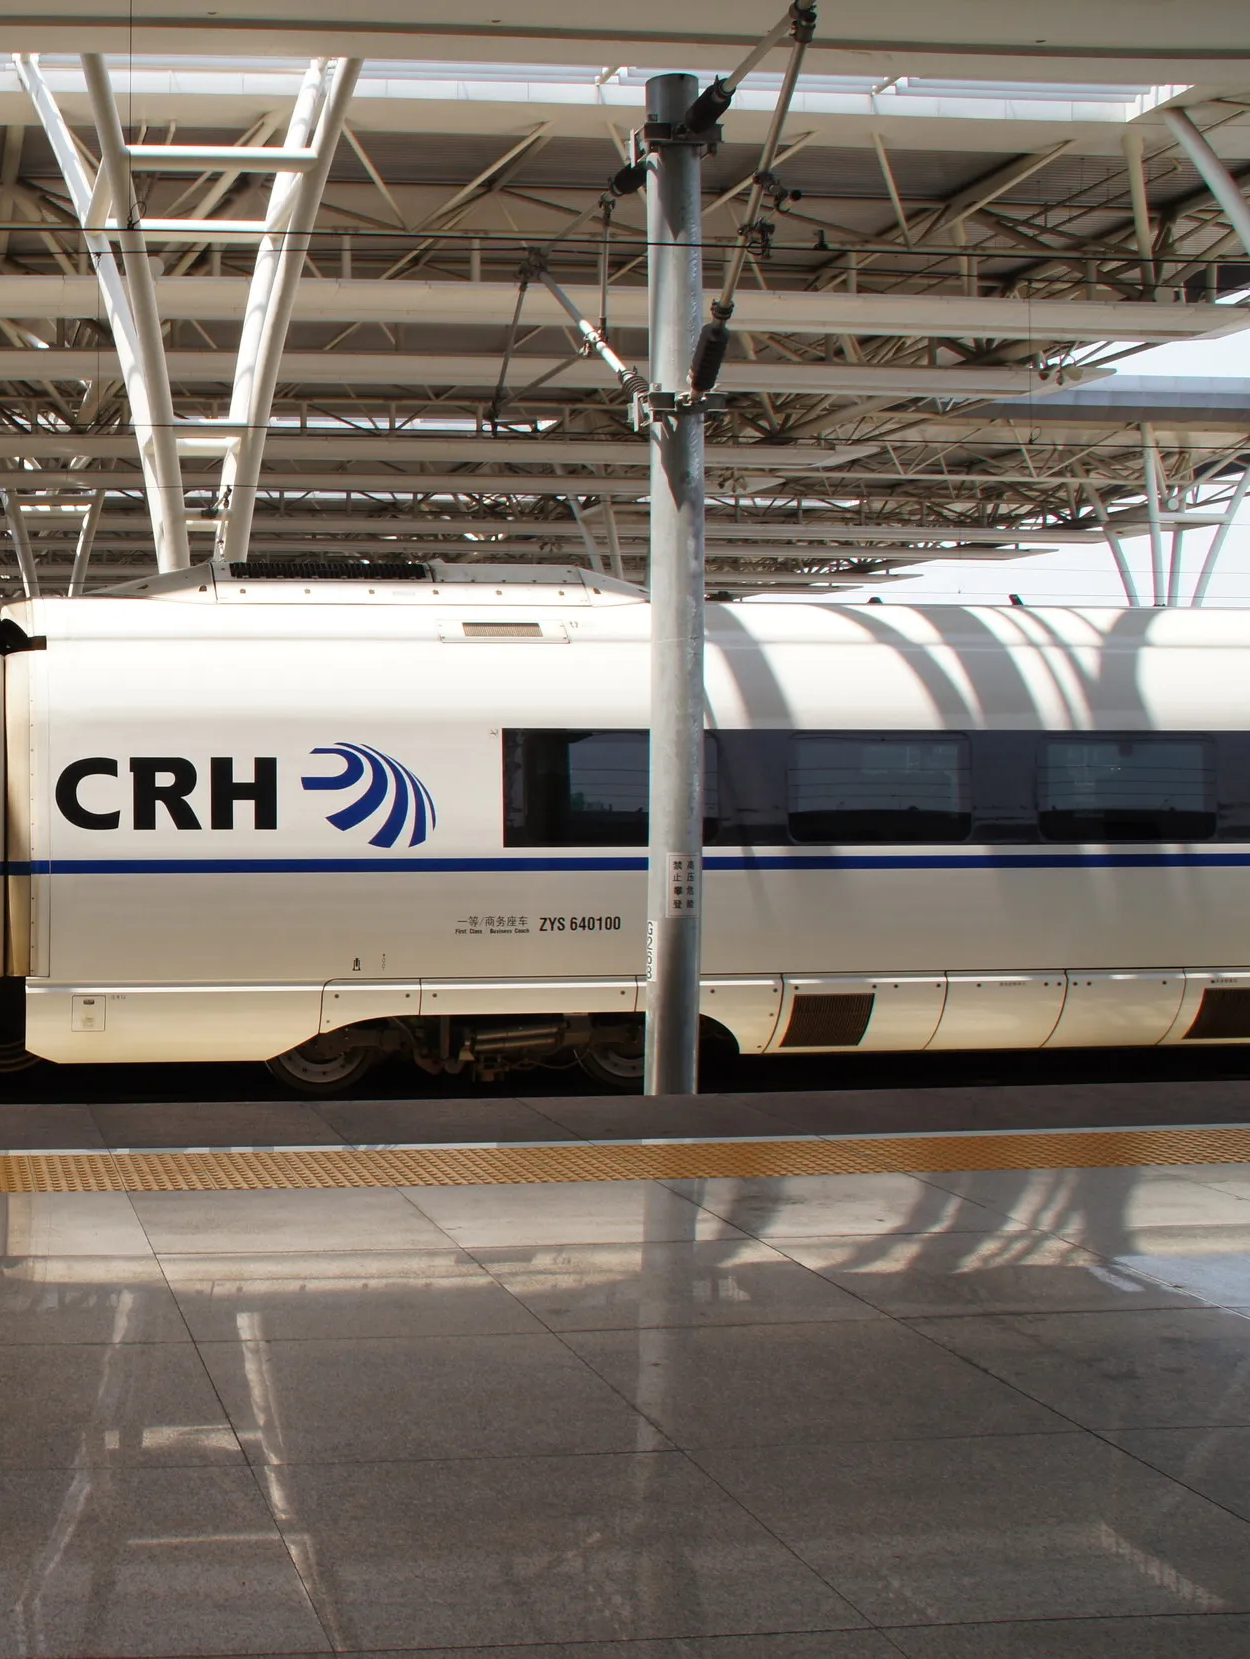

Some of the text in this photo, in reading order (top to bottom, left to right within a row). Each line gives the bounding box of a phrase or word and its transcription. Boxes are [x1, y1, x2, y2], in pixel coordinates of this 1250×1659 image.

[55, 756, 277, 831] CRH
[457, 916, 528, 927] 一等/商务座车
[539, 916, 621, 932] ZYS 640100
